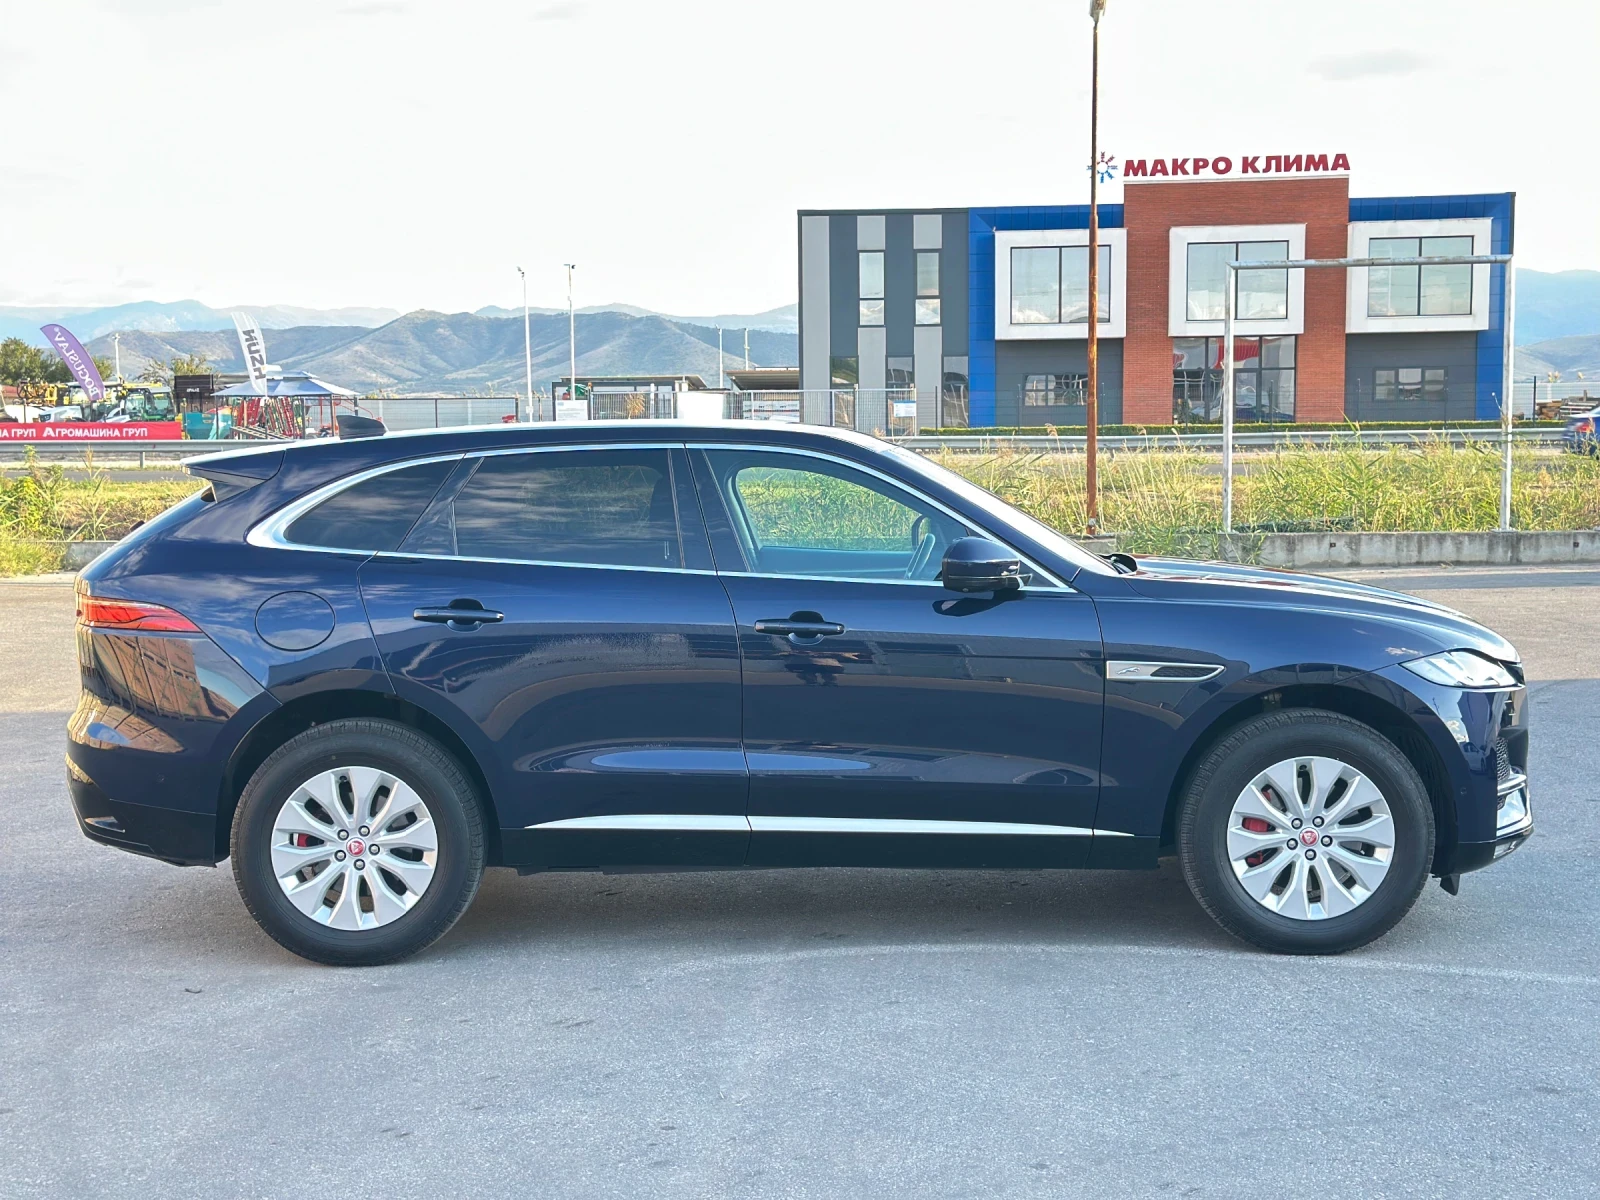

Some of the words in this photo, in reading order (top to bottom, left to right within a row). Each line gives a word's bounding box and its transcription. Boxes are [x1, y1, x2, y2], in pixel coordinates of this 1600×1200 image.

[1123, 156, 1233, 177] МАКРО
[1241, 153, 1350, 174] КЛИМА
[11, 428, 36, 438] ГРУП
[42, 426, 120, 438] АГРОМАШИНА
[123, 428, 148, 437] ГРУП
